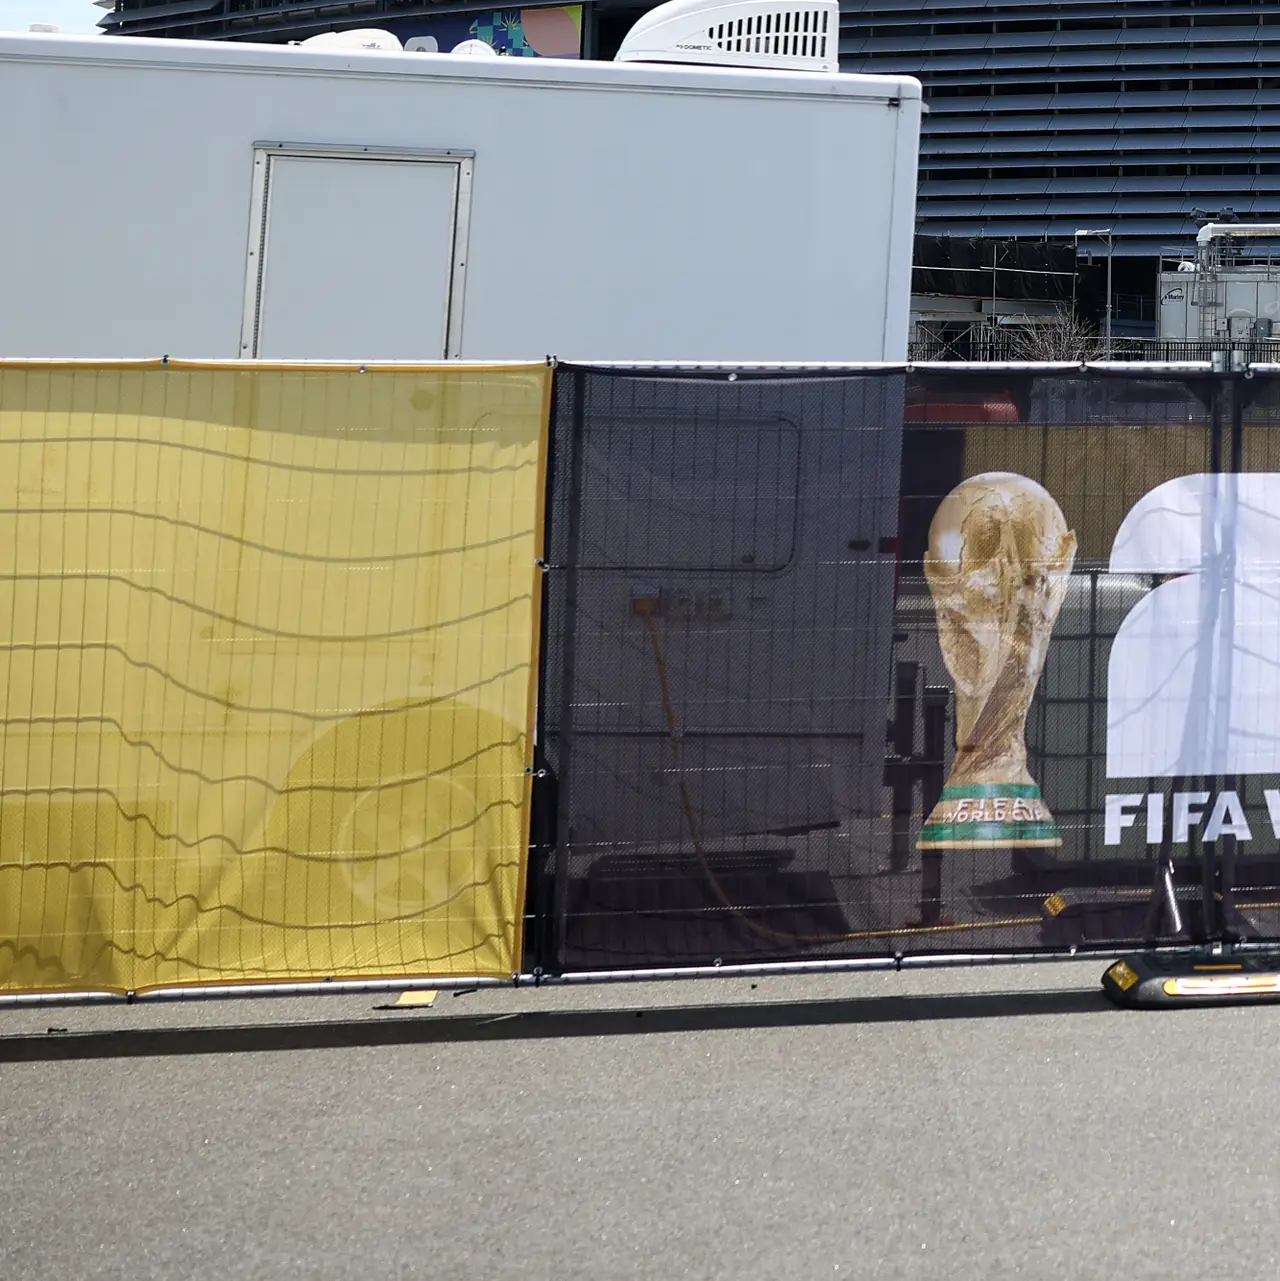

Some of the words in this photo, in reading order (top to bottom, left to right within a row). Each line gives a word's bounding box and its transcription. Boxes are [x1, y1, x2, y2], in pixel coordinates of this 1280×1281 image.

[958, 797, 1029, 810] FIFA
[942, 810, 1006, 823] WORLD
[1012, 809, 1044, 821] CUP
[1104, 790, 1252, 846] FIFA
